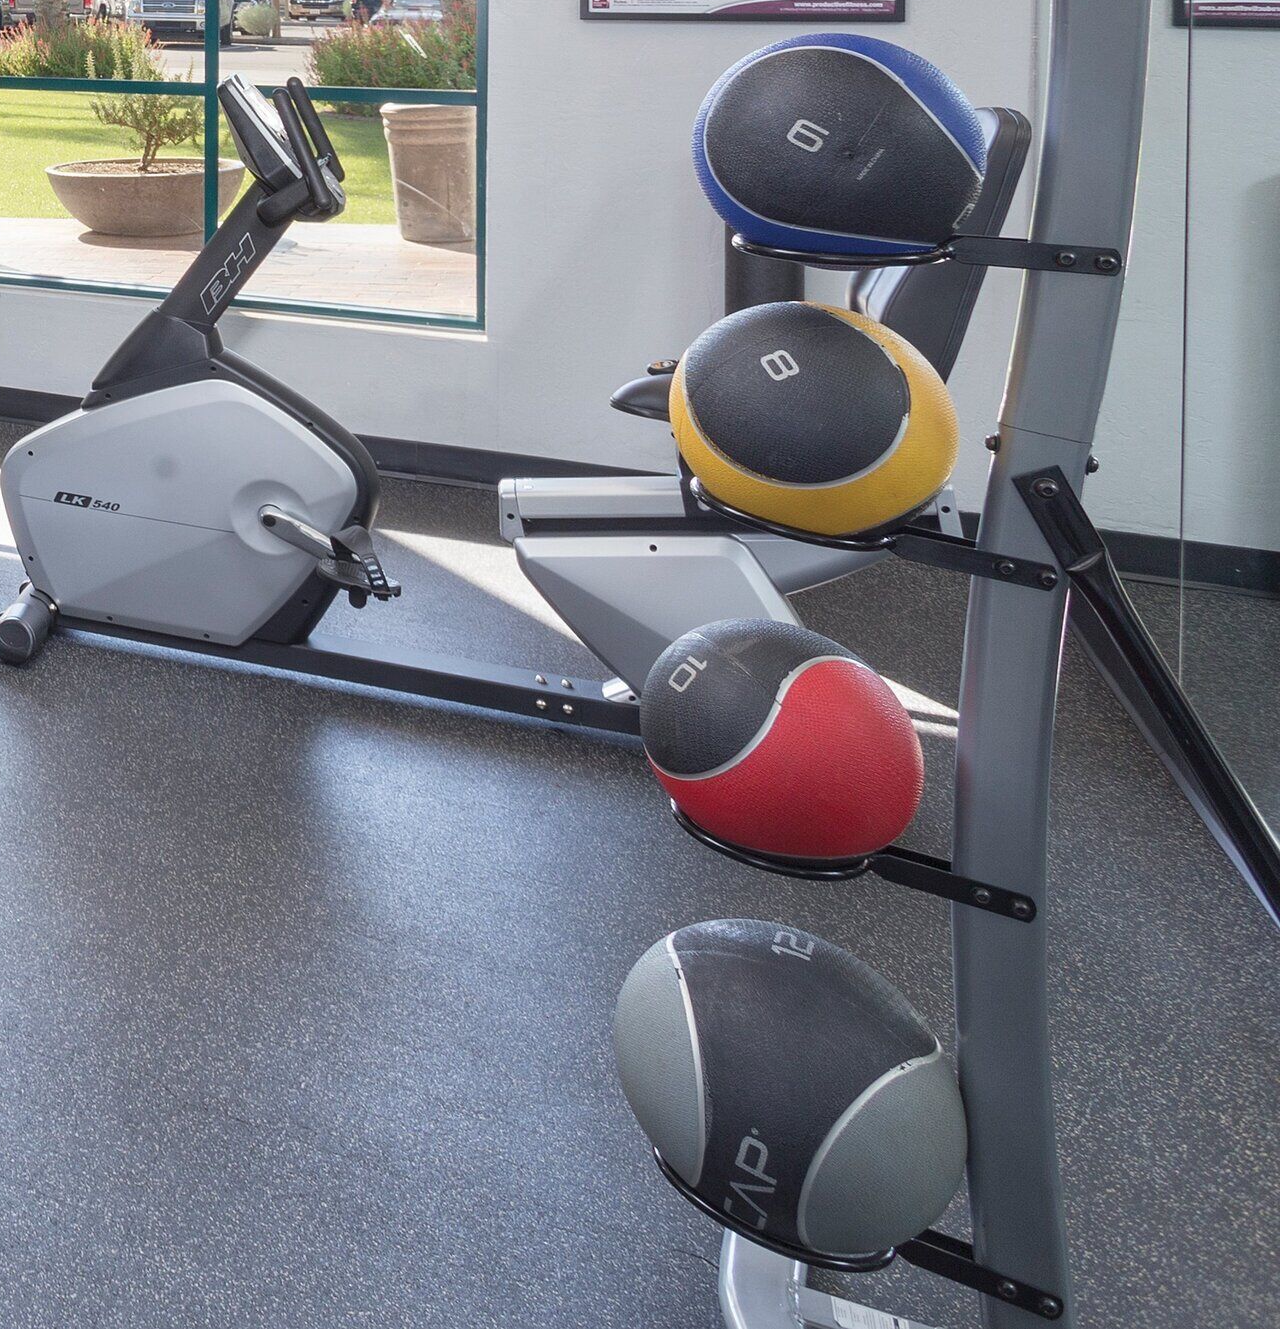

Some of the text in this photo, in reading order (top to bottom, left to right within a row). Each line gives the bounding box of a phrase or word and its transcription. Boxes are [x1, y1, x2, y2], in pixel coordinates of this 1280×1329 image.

[200, 232, 256, 315] BH
[760, 349, 800, 381] 8
[59, 493, 121, 512] LK 540
[668, 655, 708, 692] 10
[771, 931, 815, 961] 12
